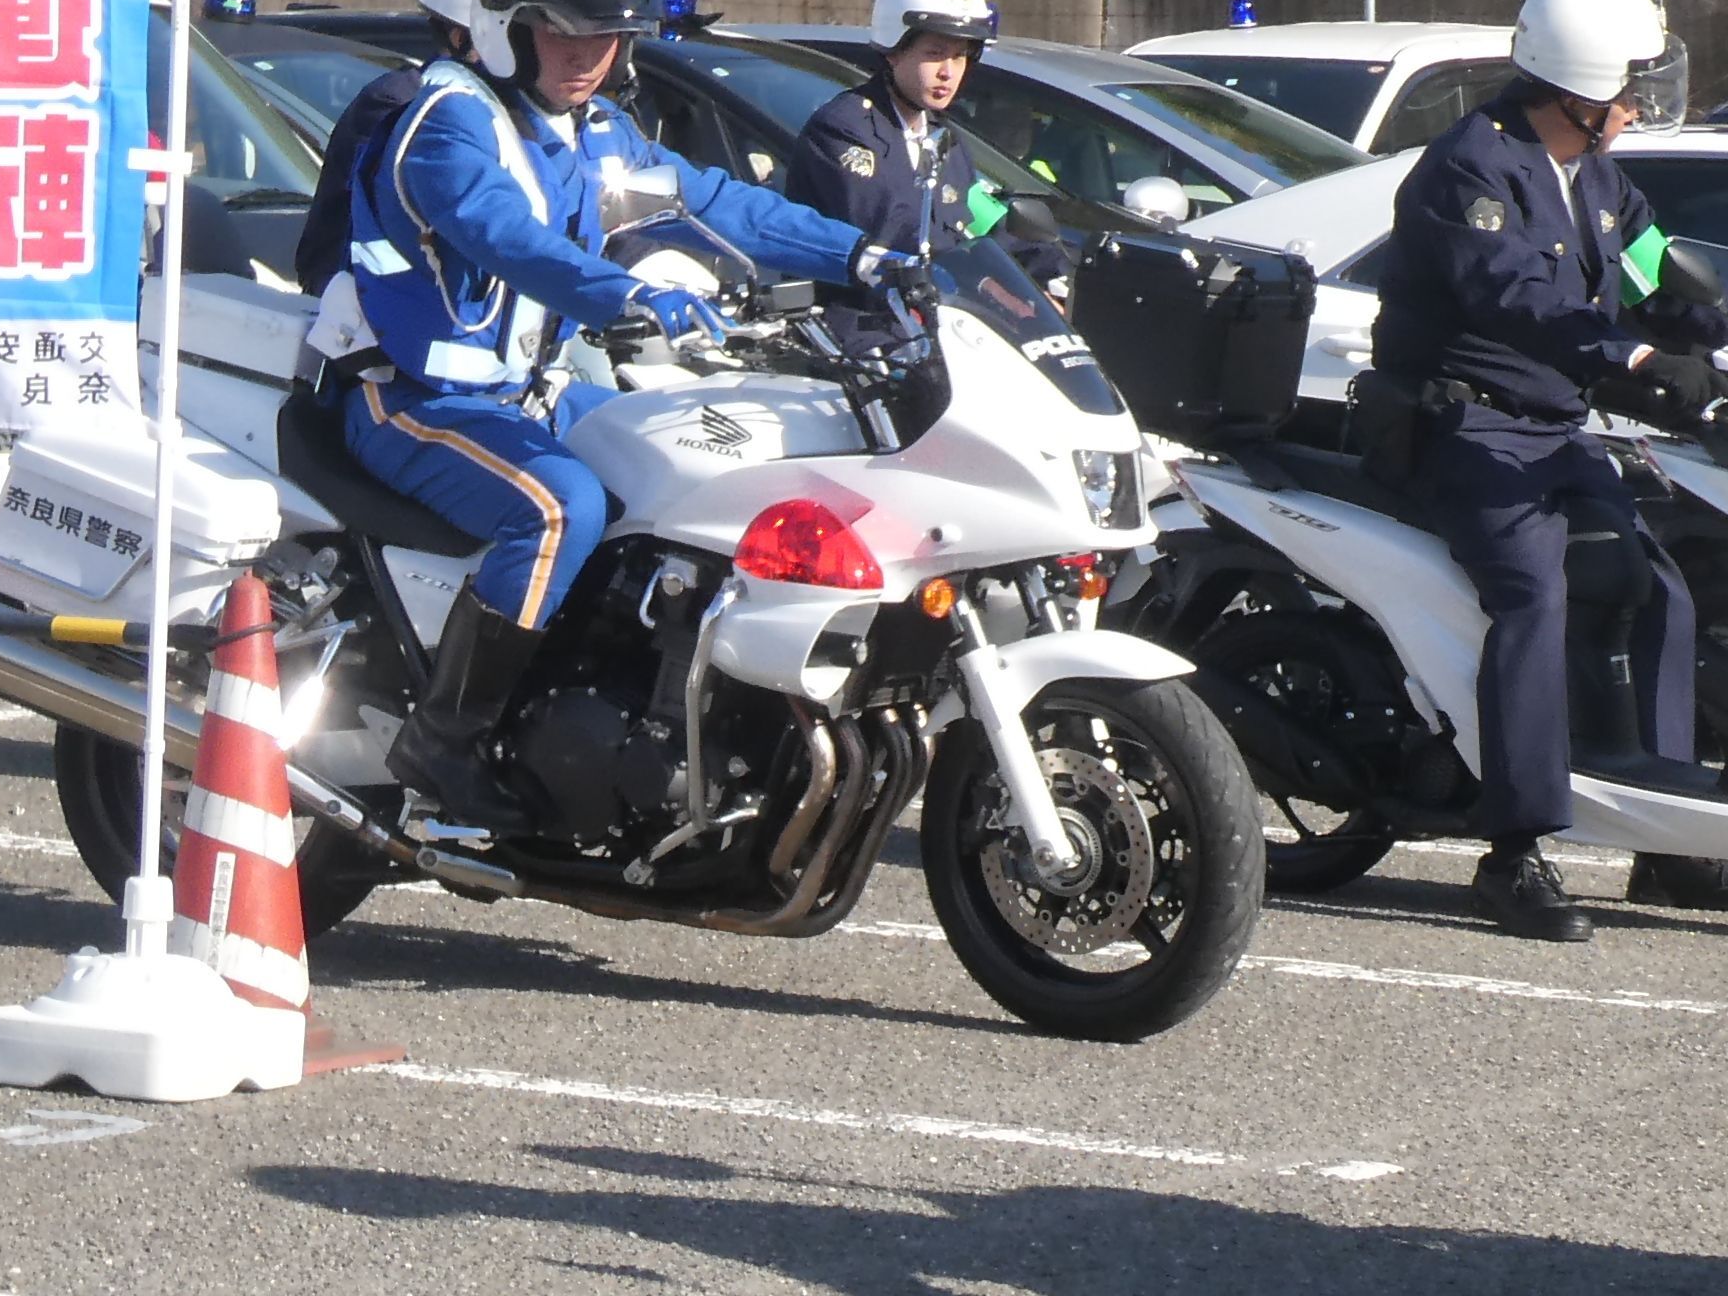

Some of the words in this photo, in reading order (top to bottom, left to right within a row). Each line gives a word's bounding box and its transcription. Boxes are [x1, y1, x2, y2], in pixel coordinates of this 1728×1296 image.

[675, 436, 744, 459] HONDA
[3, 485, 143, 560] 奈良県警察
